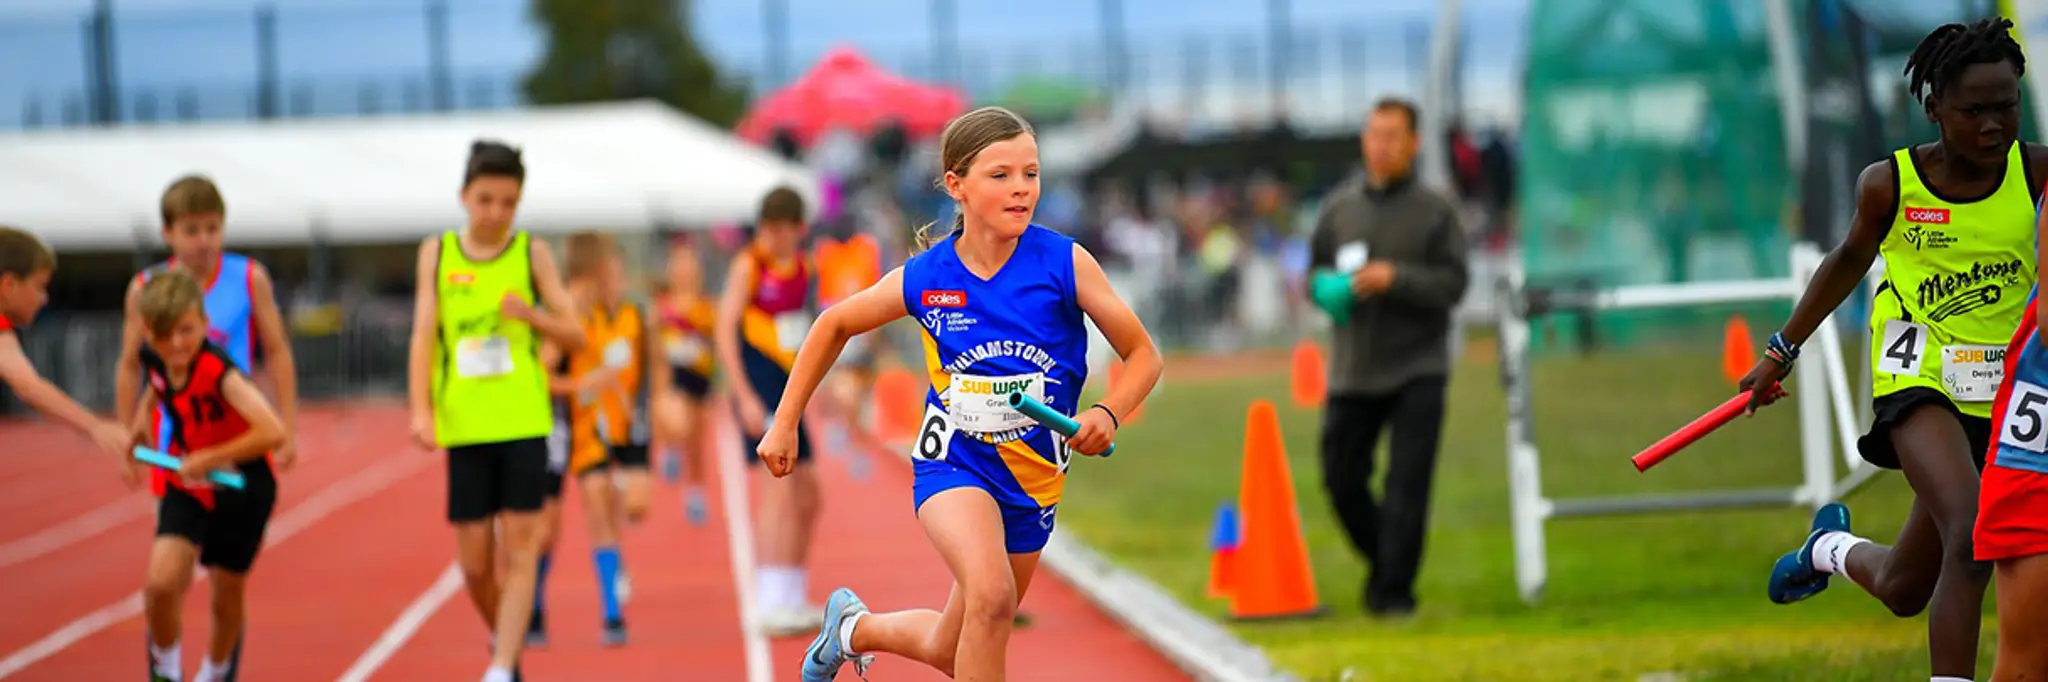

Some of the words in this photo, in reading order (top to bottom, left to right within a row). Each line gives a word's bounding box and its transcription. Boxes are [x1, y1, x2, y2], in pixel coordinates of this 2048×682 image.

[1910, 211, 1944, 221] coles
[928, 293, 961, 304] coles
[1916, 259, 2022, 310] Mentone
[1886, 326, 1918, 370] 4
[1951, 349, 2006, 364] SUBWA
[960, 379, 1033, 395] SUBWAY
[2010, 390, 2048, 443] 5
[920, 415, 947, 460] 6
